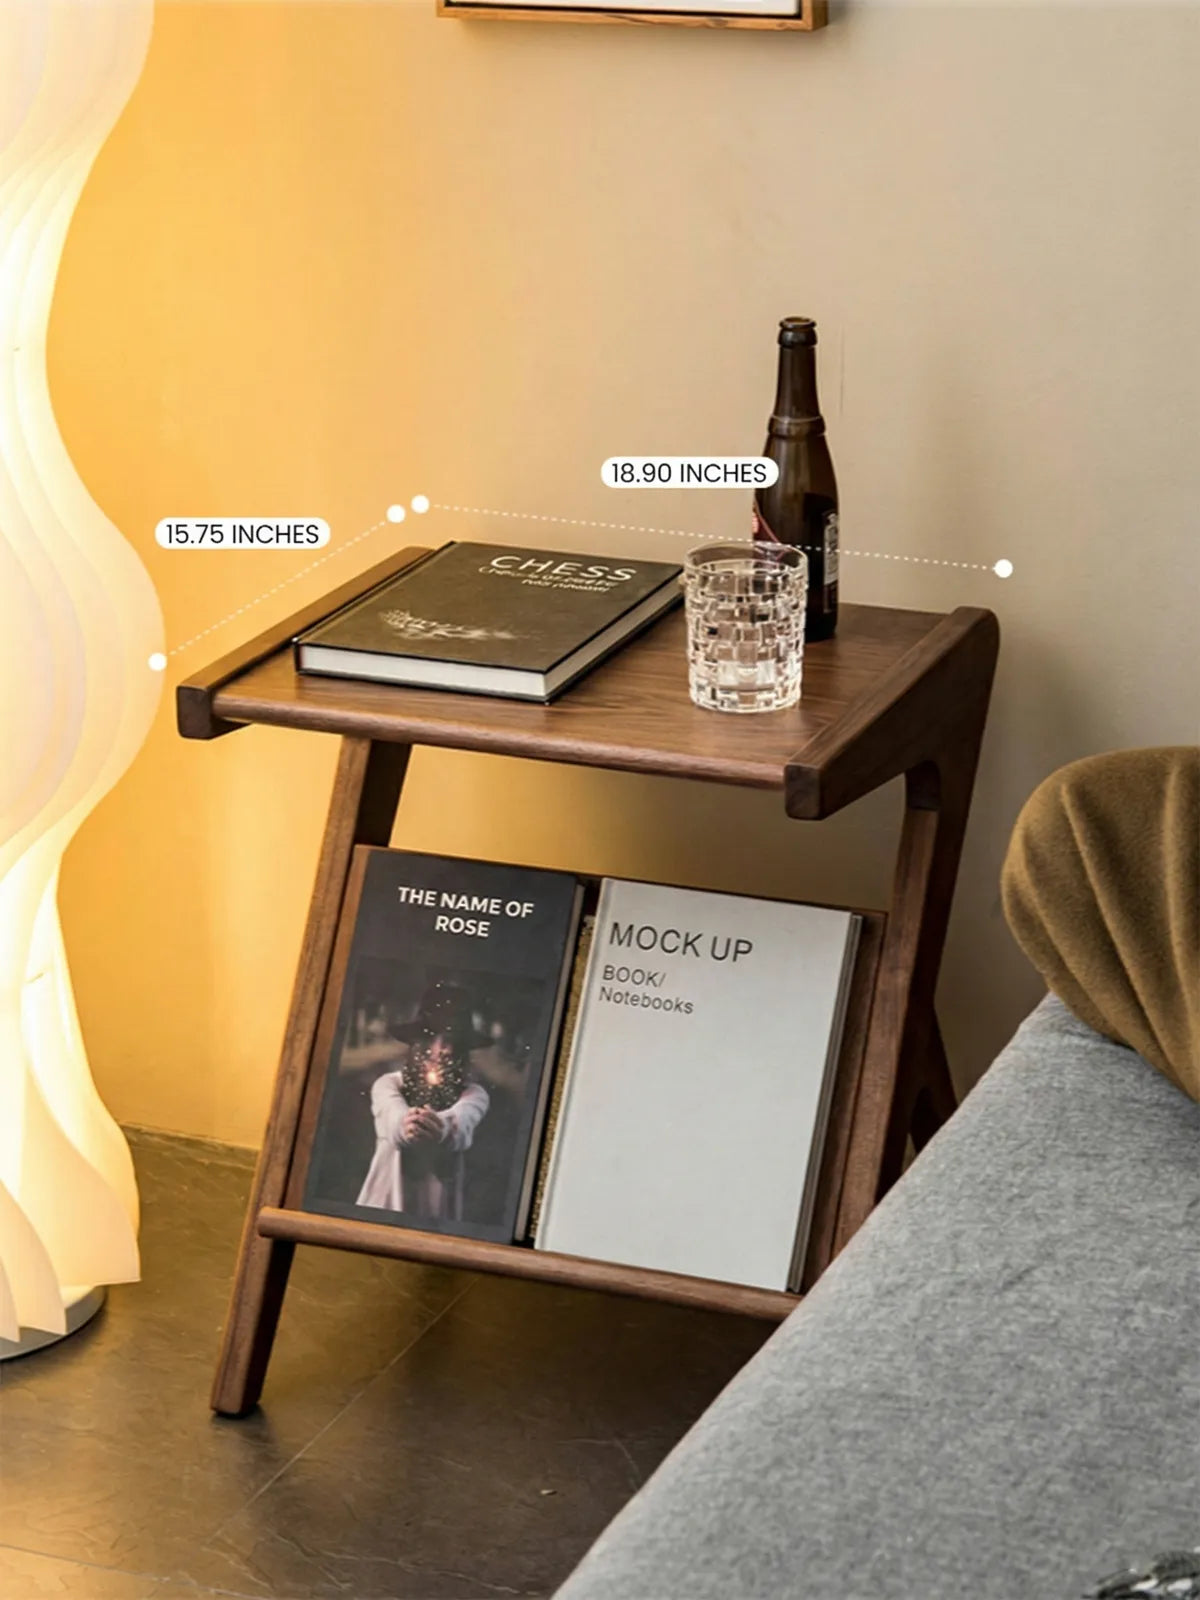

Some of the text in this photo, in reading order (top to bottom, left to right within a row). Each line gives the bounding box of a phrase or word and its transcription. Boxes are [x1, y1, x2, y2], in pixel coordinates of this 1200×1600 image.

[490, 555, 637, 581] CHESS
[398, 886, 535, 919] THE NAME OF
[434, 915, 491, 938] ROSE
[609, 922, 754, 963] MOCK UP
[602, 964, 666, 988] BOOK/
[598, 986, 695, 1015] Notebooks
